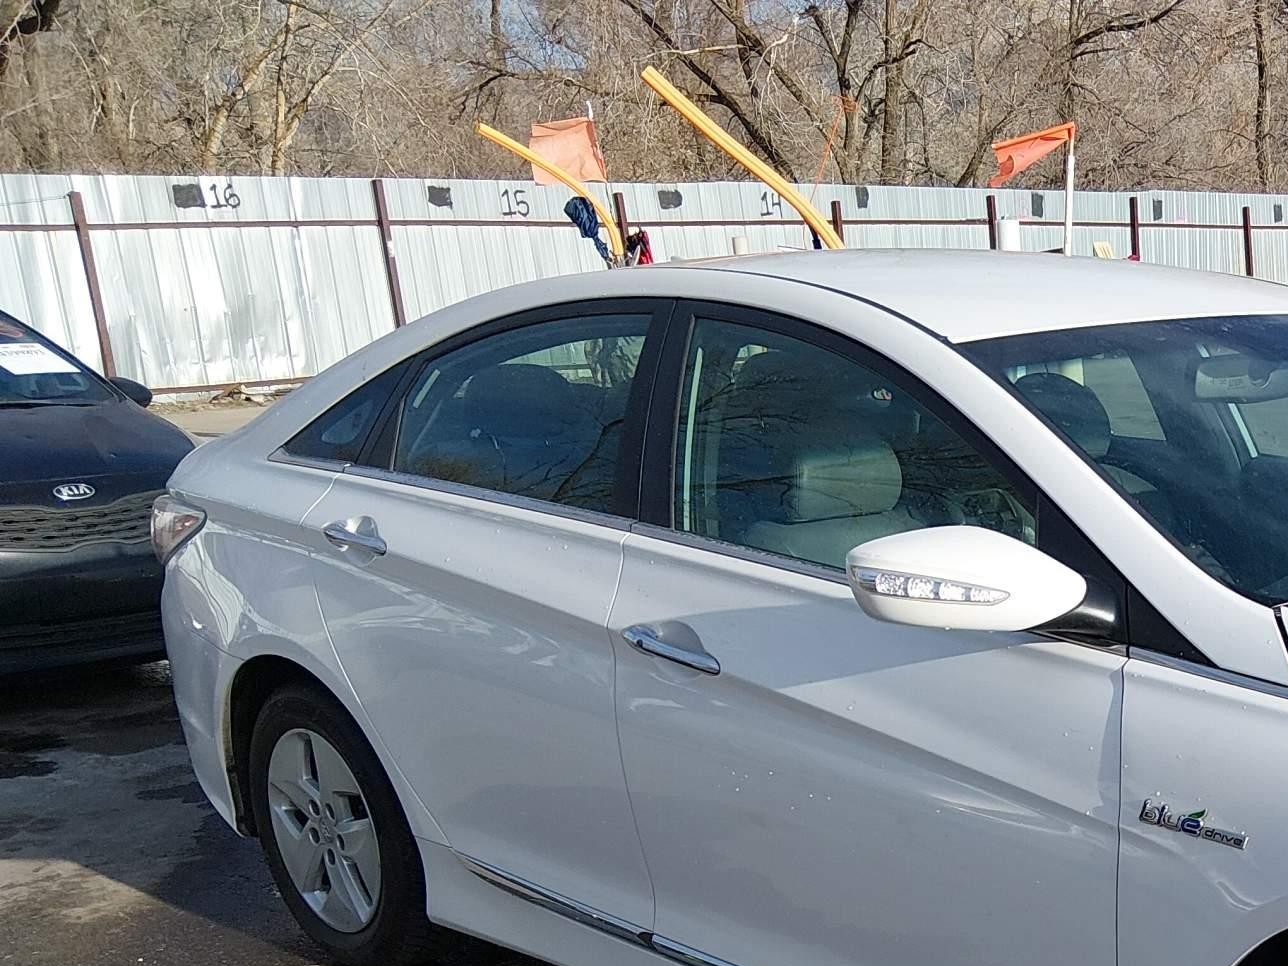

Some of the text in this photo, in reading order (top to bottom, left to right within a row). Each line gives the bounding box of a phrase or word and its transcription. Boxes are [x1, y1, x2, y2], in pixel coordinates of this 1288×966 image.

[208, 183, 240, 208] 16
[501, 188, 530, 217] 15
[760, 191, 783, 219] 14
[57, 484, 93, 498] KIA
[1139, 798, 1208, 838] blue
